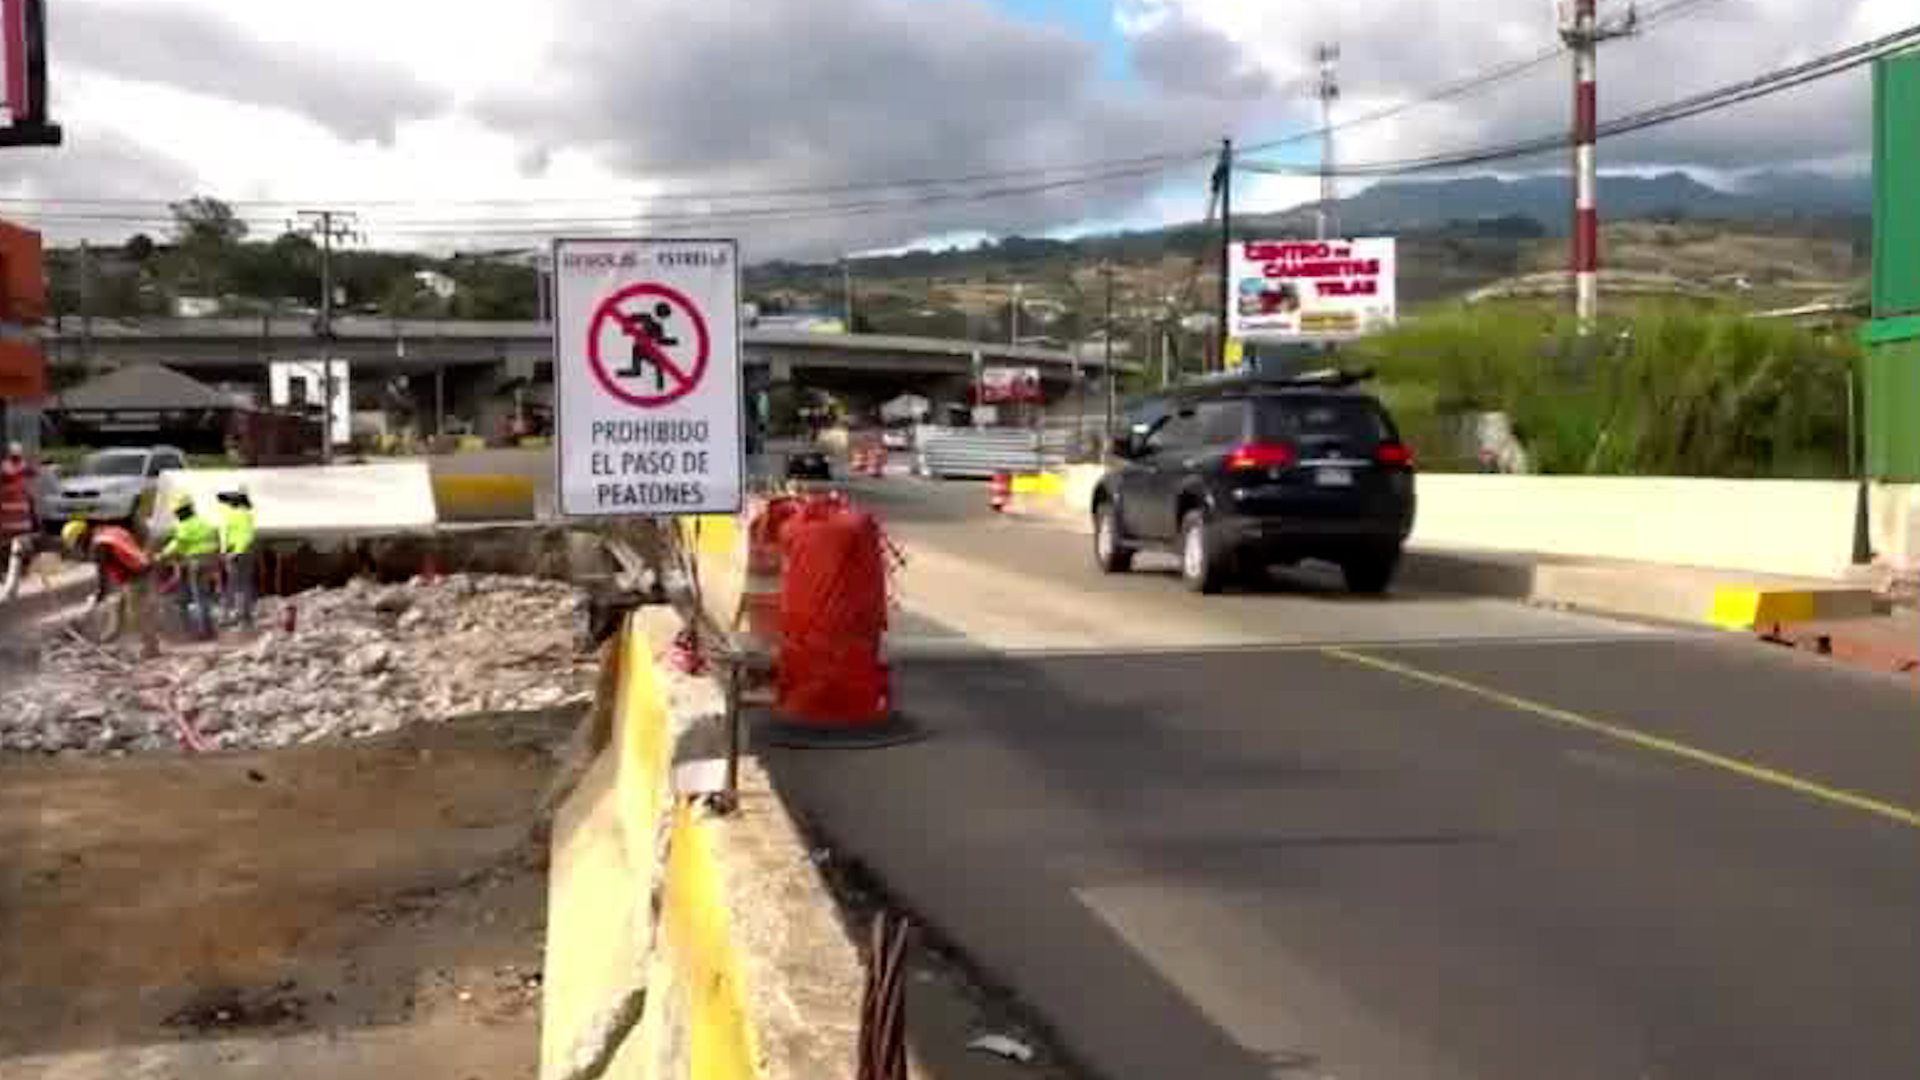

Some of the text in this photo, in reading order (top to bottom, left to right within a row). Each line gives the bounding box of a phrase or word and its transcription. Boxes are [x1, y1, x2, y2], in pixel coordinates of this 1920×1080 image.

[592, 420, 709, 444] PROHIBIDO
[592, 452, 708, 475] EL PASO DE
[598, 484, 703, 506] PEATONES
